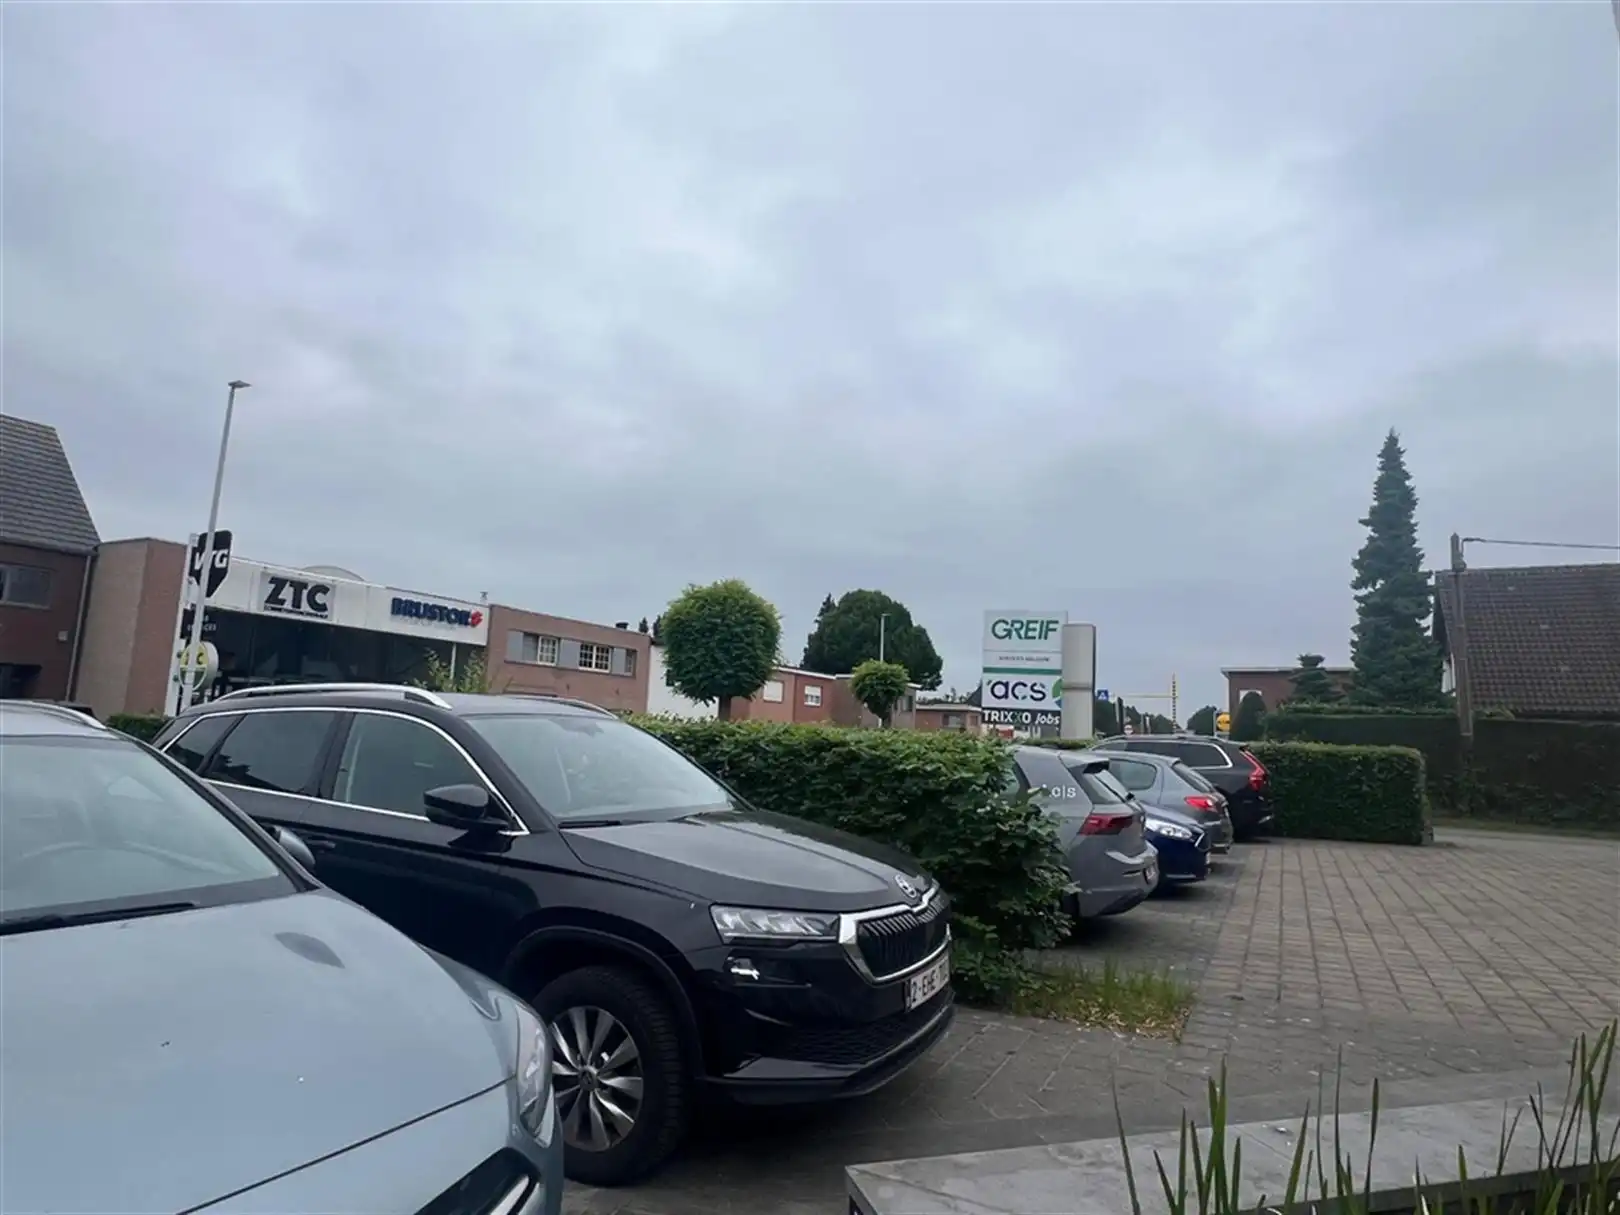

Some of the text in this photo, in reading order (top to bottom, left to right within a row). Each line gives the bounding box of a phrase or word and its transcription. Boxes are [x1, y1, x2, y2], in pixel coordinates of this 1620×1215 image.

[264, 576, 331, 612] ZTC
[991, 619, 1059, 640] GREIF
[990, 680, 1047, 701] acs
[983, 710, 1031, 724] TRIXXO
